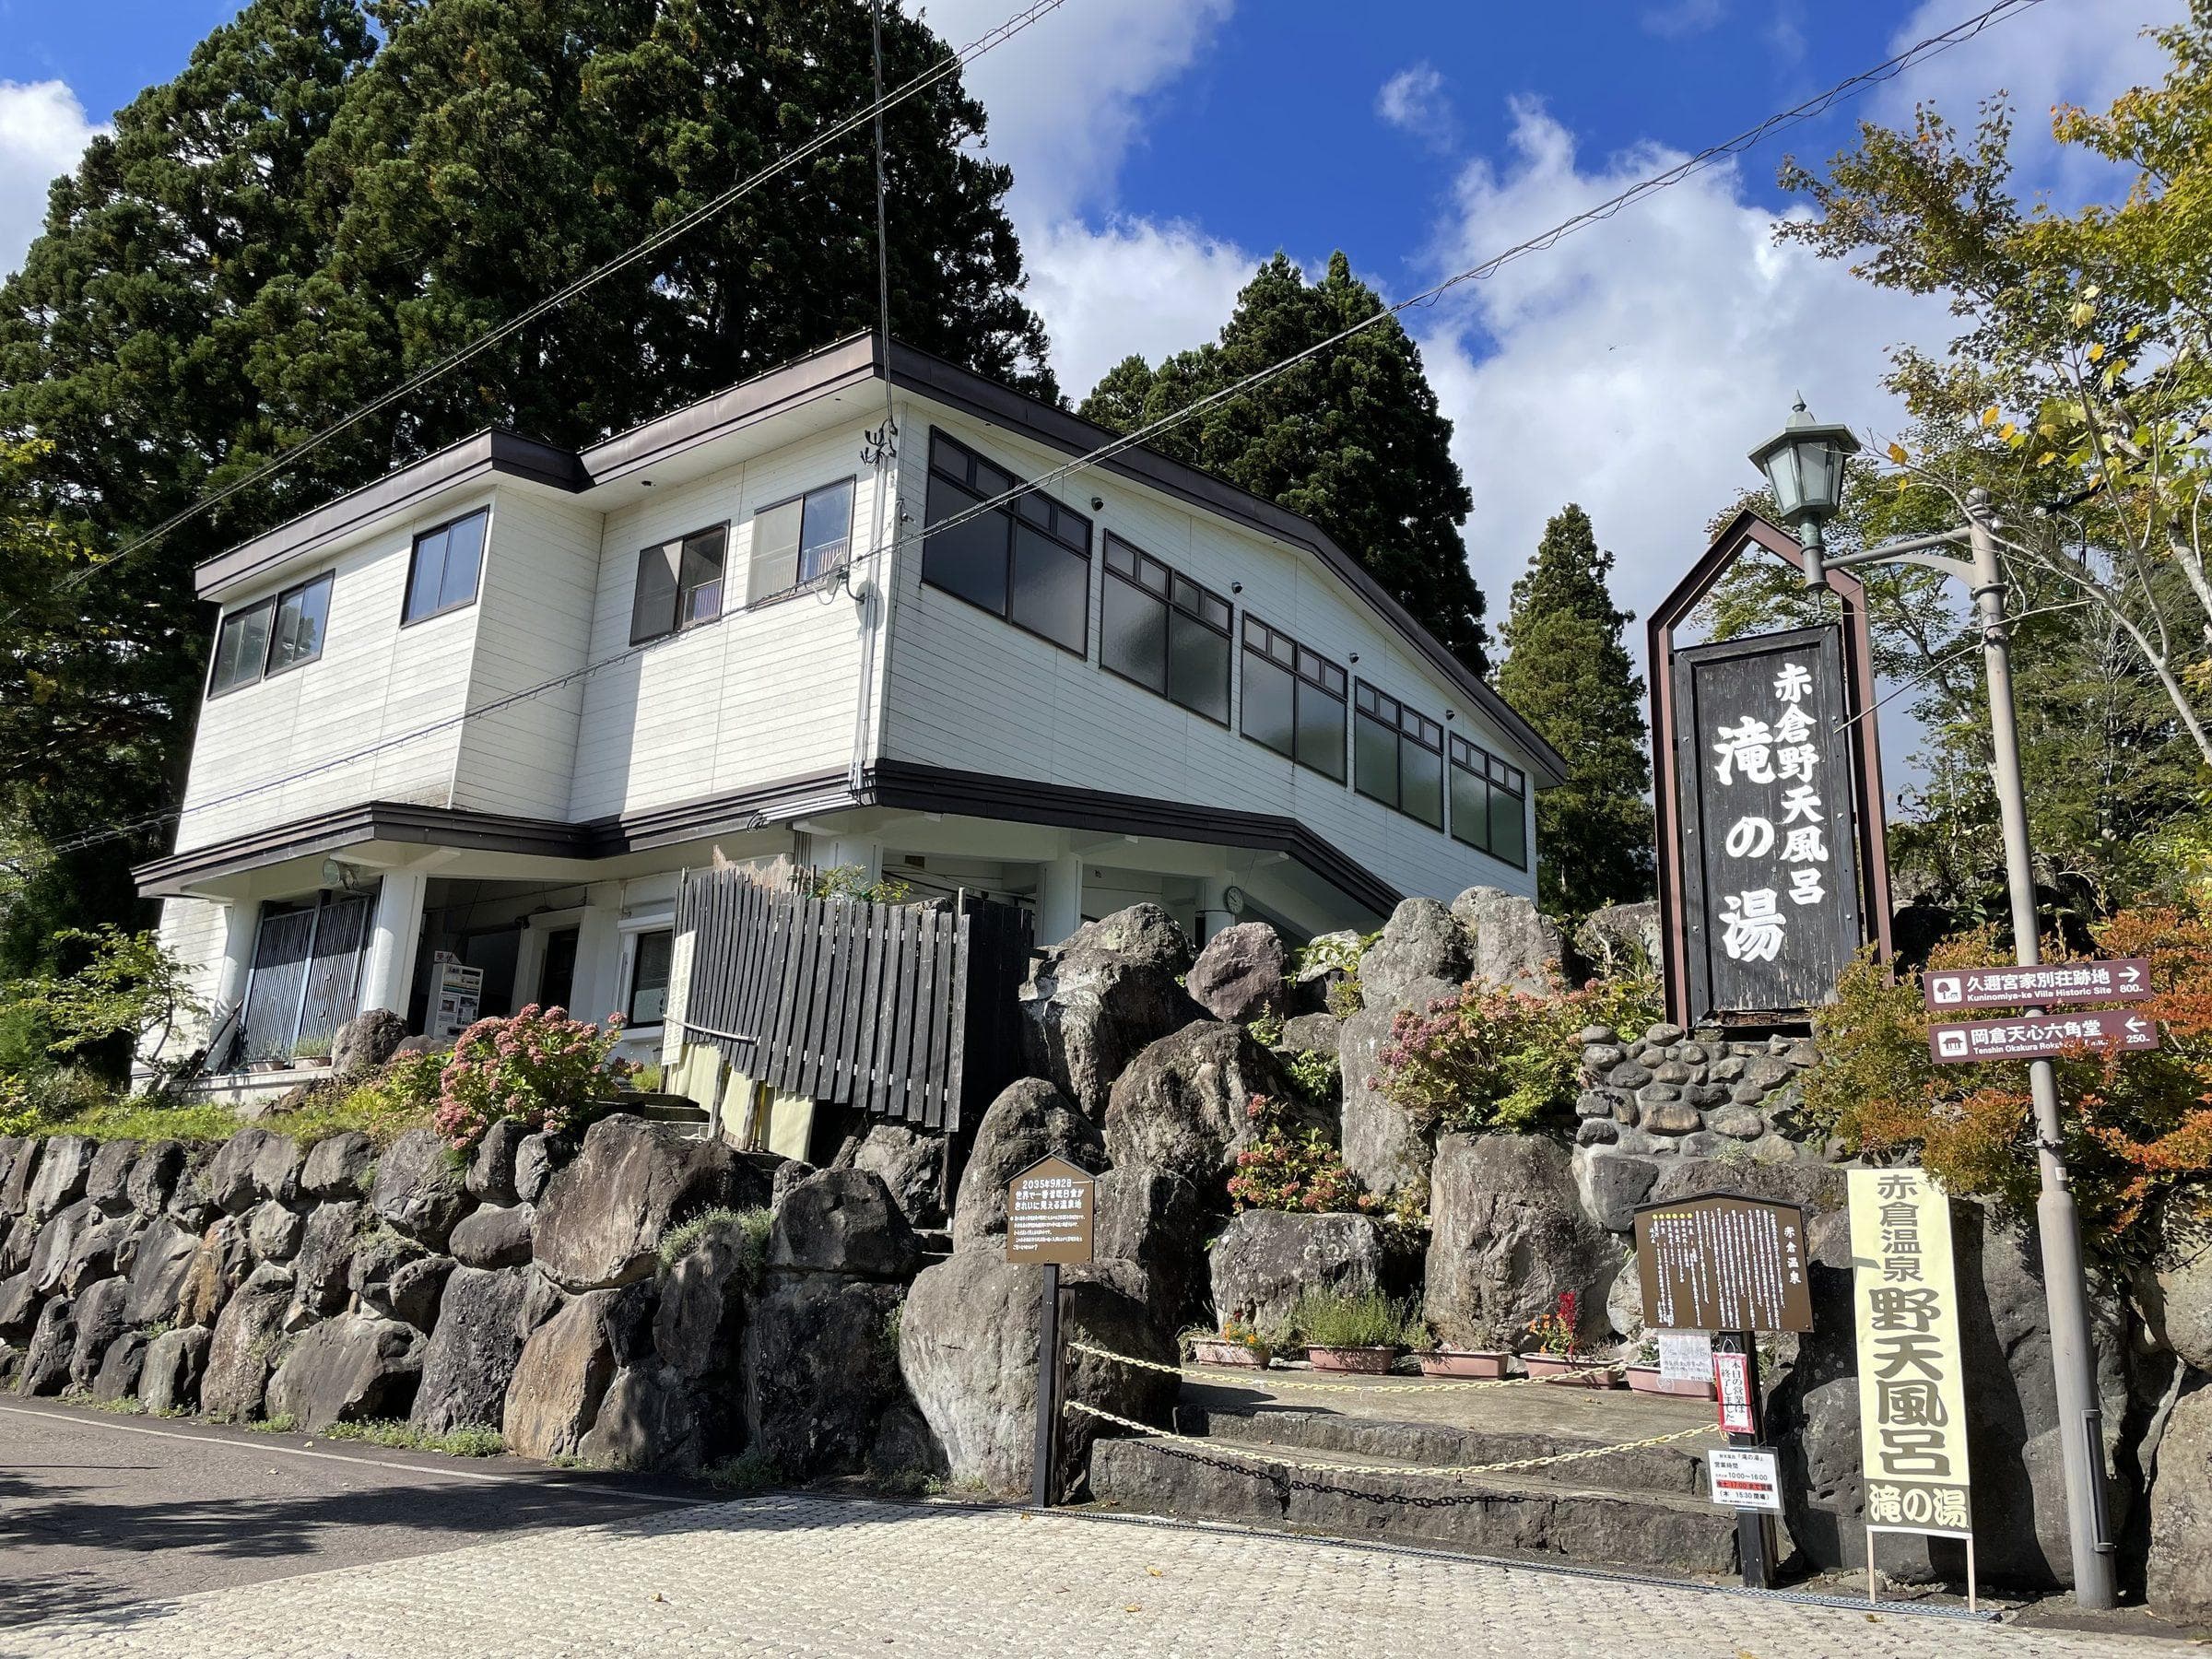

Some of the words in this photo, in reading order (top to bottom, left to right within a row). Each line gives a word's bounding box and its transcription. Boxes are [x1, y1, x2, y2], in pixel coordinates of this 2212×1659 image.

[1772, 663, 1830, 906] 赤倉野天風呂
[1713, 715, 1787, 963] 滝の湯
[1967, 992, 2032, 1003] Kuninomiya-ke
[2034, 990, 2053, 999] Villa
[2056, 988, 2091, 997] Historic
[2094, 986, 2112, 995] Site
[1971, 1019, 2103, 1046] 岡倉天心六角堂
[1973, 1046, 2004, 1055] Tenshin
[2005, 1043, 2039, 1053] Okakura
[1783, 1226, 1802, 1285] 赤倉温泉
[1877, 1174, 1924, 1283] 赤倉温泉
[1722, 1369, 1735, 1423] 終了しました
[1732, 1359, 1746, 1414] 本日の営業は
[1868, 1287, 1952, 1477] 野天風呂
[1868, 1483, 1969, 1530] 滝の湯
